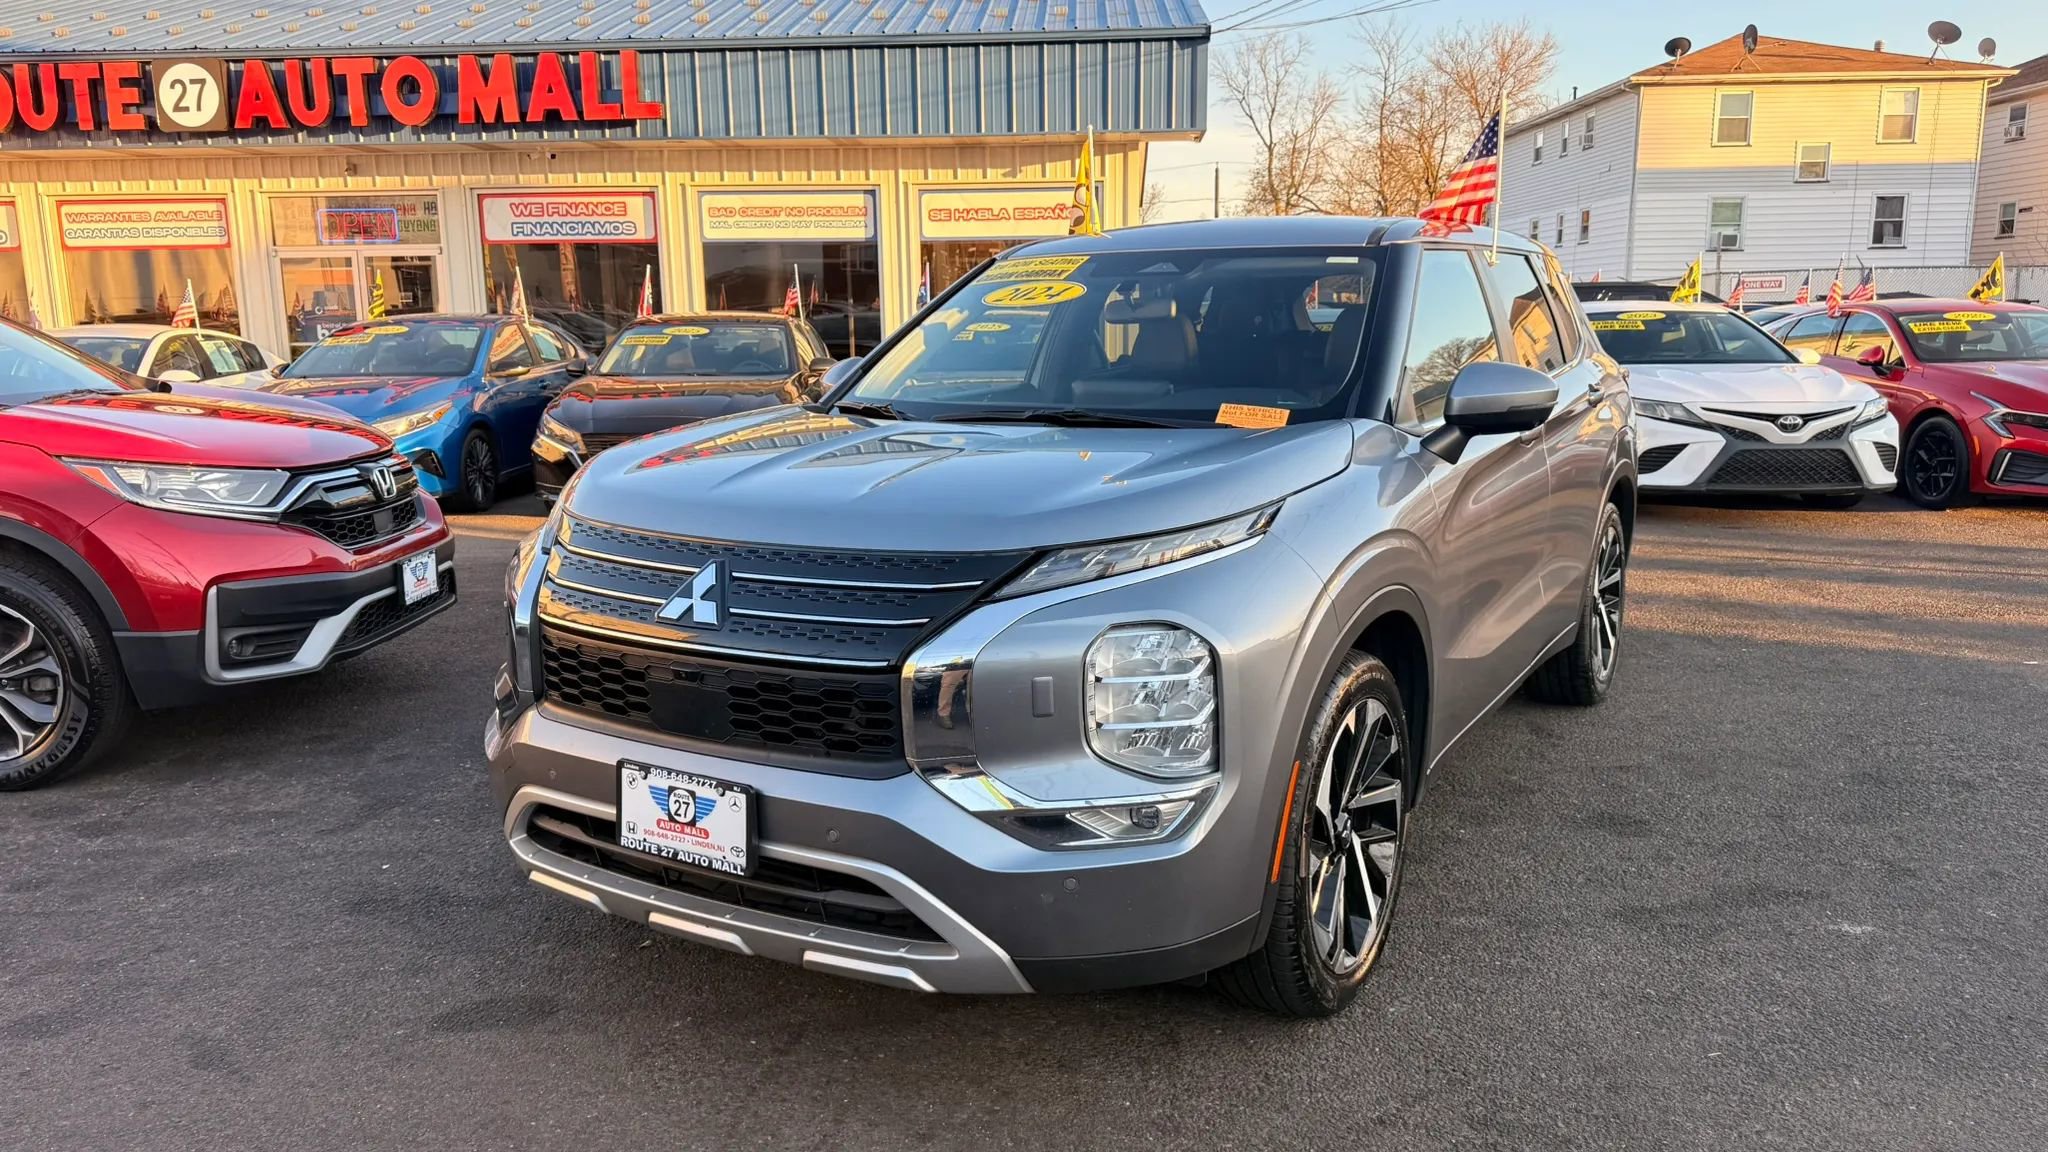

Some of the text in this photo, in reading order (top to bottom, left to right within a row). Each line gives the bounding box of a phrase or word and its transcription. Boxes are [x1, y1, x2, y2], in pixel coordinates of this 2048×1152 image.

[0, 49, 663, 131] UTE 27 AUTO MALL
[65, 210, 223, 223] WARRANTIES AVAILABLE
[510, 201, 627, 217] WE FINANCE
[708, 207, 867, 218] BAD CREDIT NO PROBLEM
[928, 208, 951, 222] SE
[954, 208, 1010, 221] HABLA
[322, 213, 397, 241] OPEN
[511, 221, 637, 236] FINANCIAMOS
[709, 220, 868, 229] MAL CREDITO NO HAY PROBLEMA
[64, 226, 226, 239] GARANTIAS DISPONIBLES
[1014, 268, 1070, 279] CARFAX
[1743, 280, 1780, 289] ONE WAY
[992, 285, 1075, 302] 2024
[650, 767, 717, 789] 908-648-2727
[673, 792, 690, 801] ROUTE
[673, 799, 691, 818] 27
[643, 828, 685, 843] 908-648-2727
[659, 820, 706, 838] AUTO MALL
[620, 836, 745, 876] ROUTE 27 AUTO MALL
